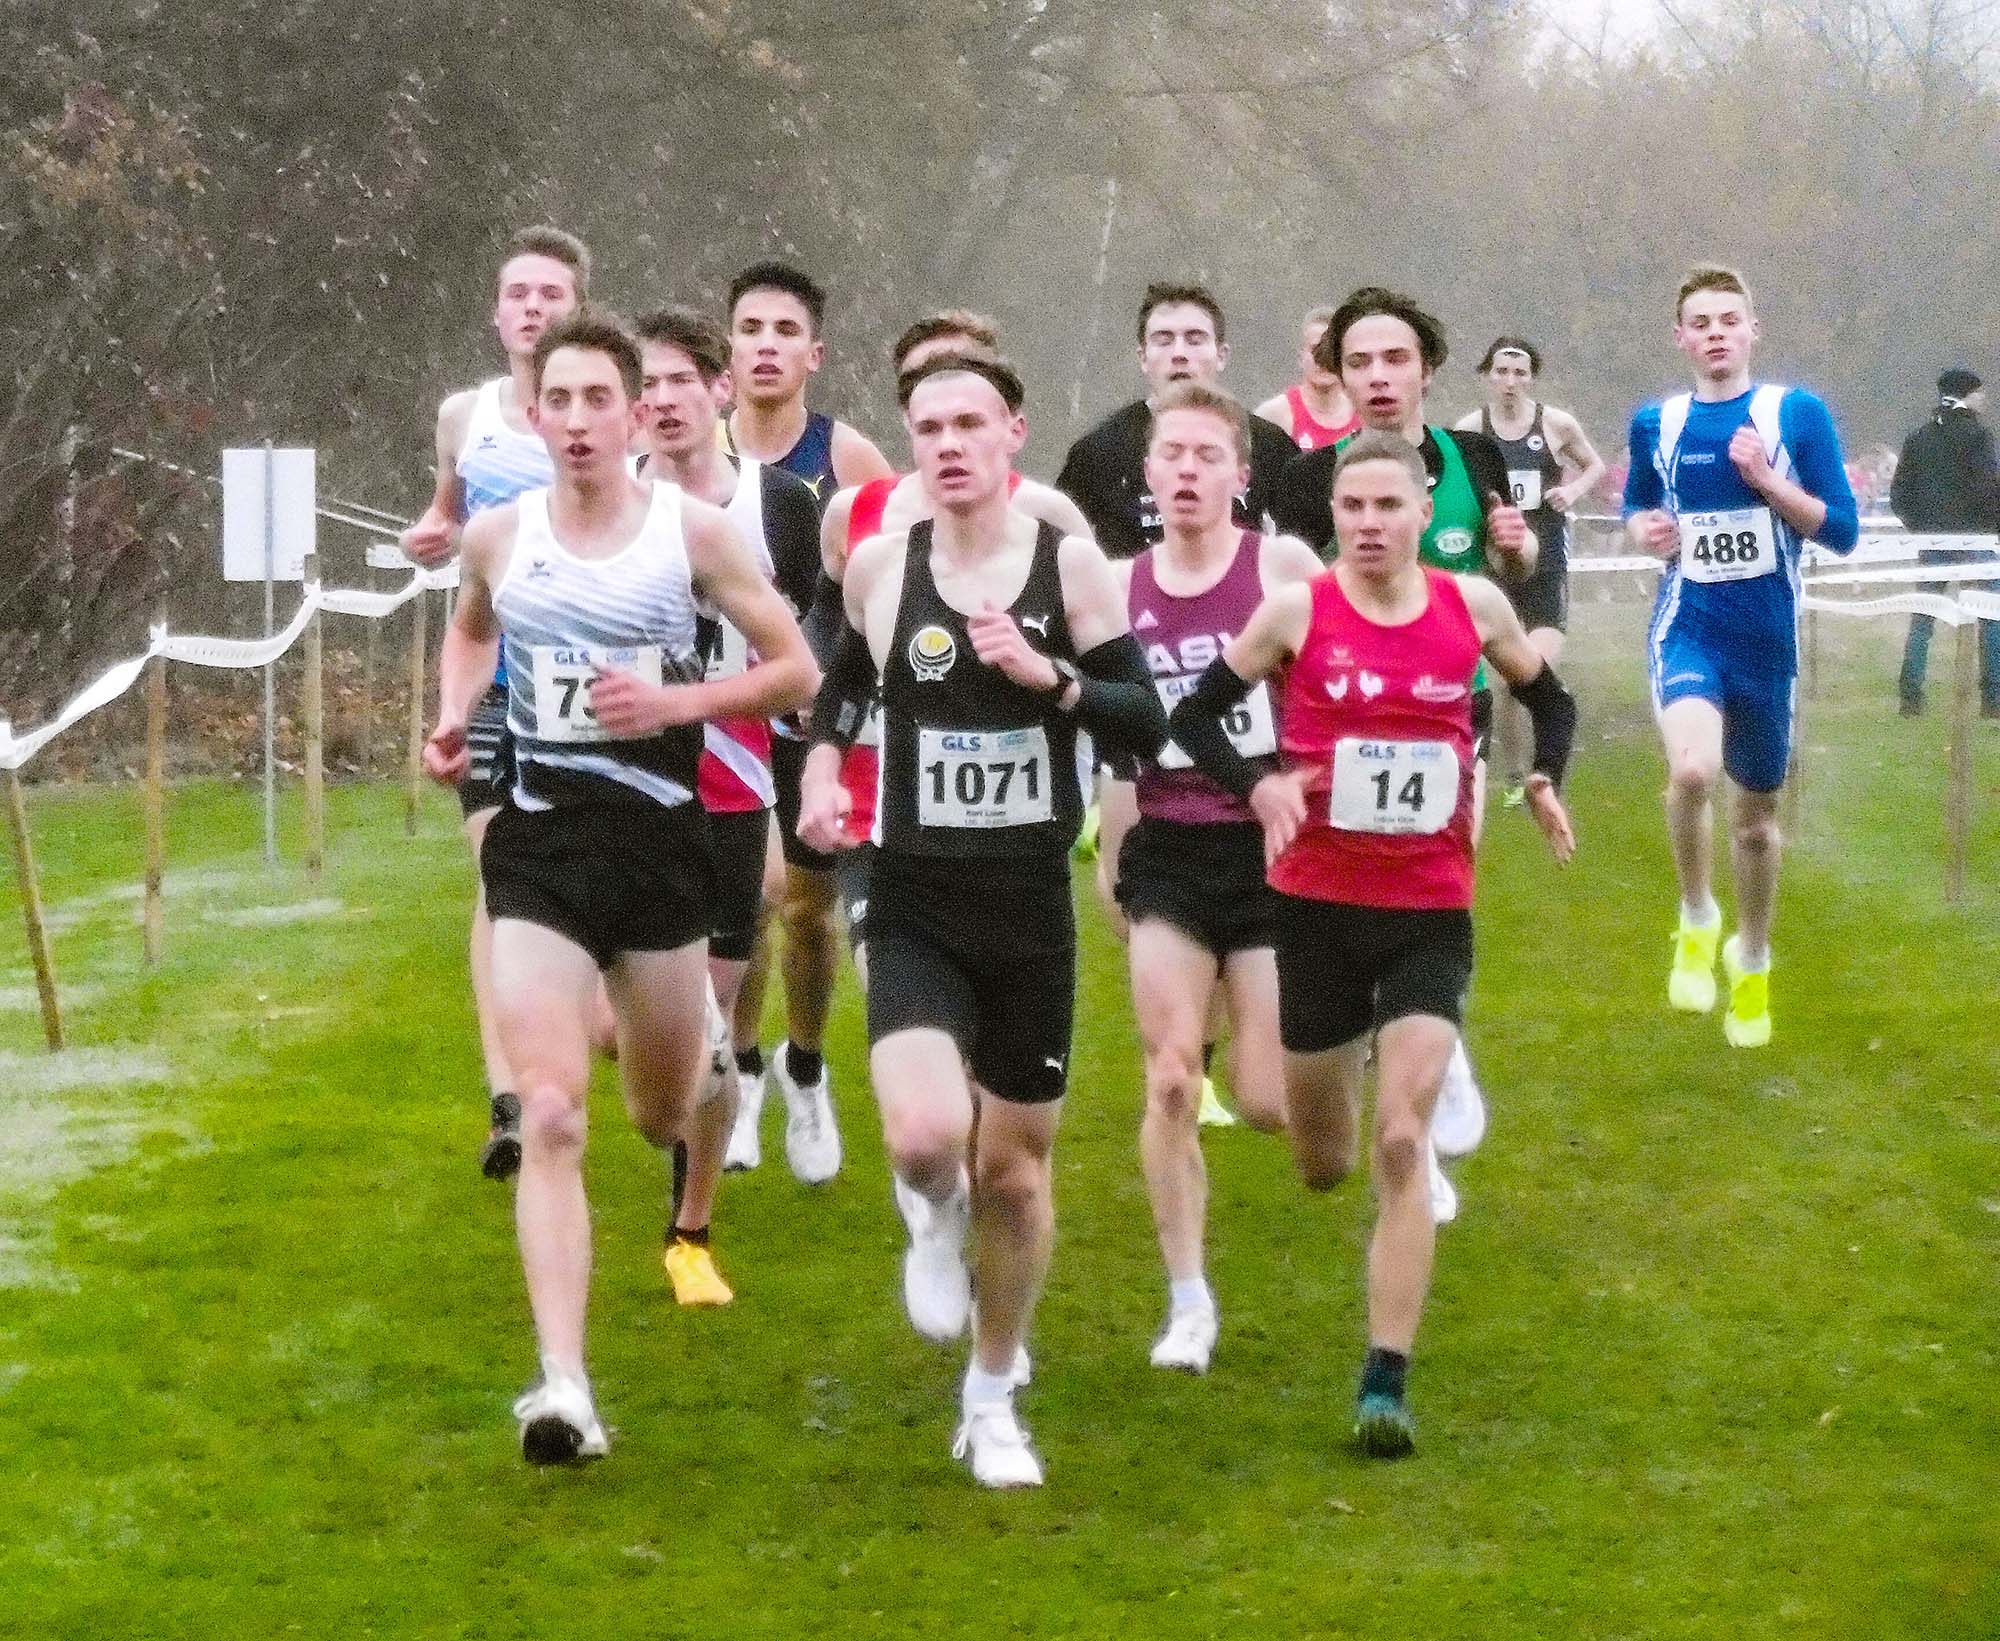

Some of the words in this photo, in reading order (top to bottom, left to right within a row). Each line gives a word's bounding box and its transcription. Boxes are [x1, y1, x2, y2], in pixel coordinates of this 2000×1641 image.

[1691, 515, 1718, 527] GLS
[1693, 531, 1760, 565] 488
[554, 650, 590, 665] GLS
[941, 735, 982, 752] GLS
[1358, 744, 1397, 759] GLS
[925, 756, 1039, 805] 1071
[1370, 769, 1426, 812] 14
